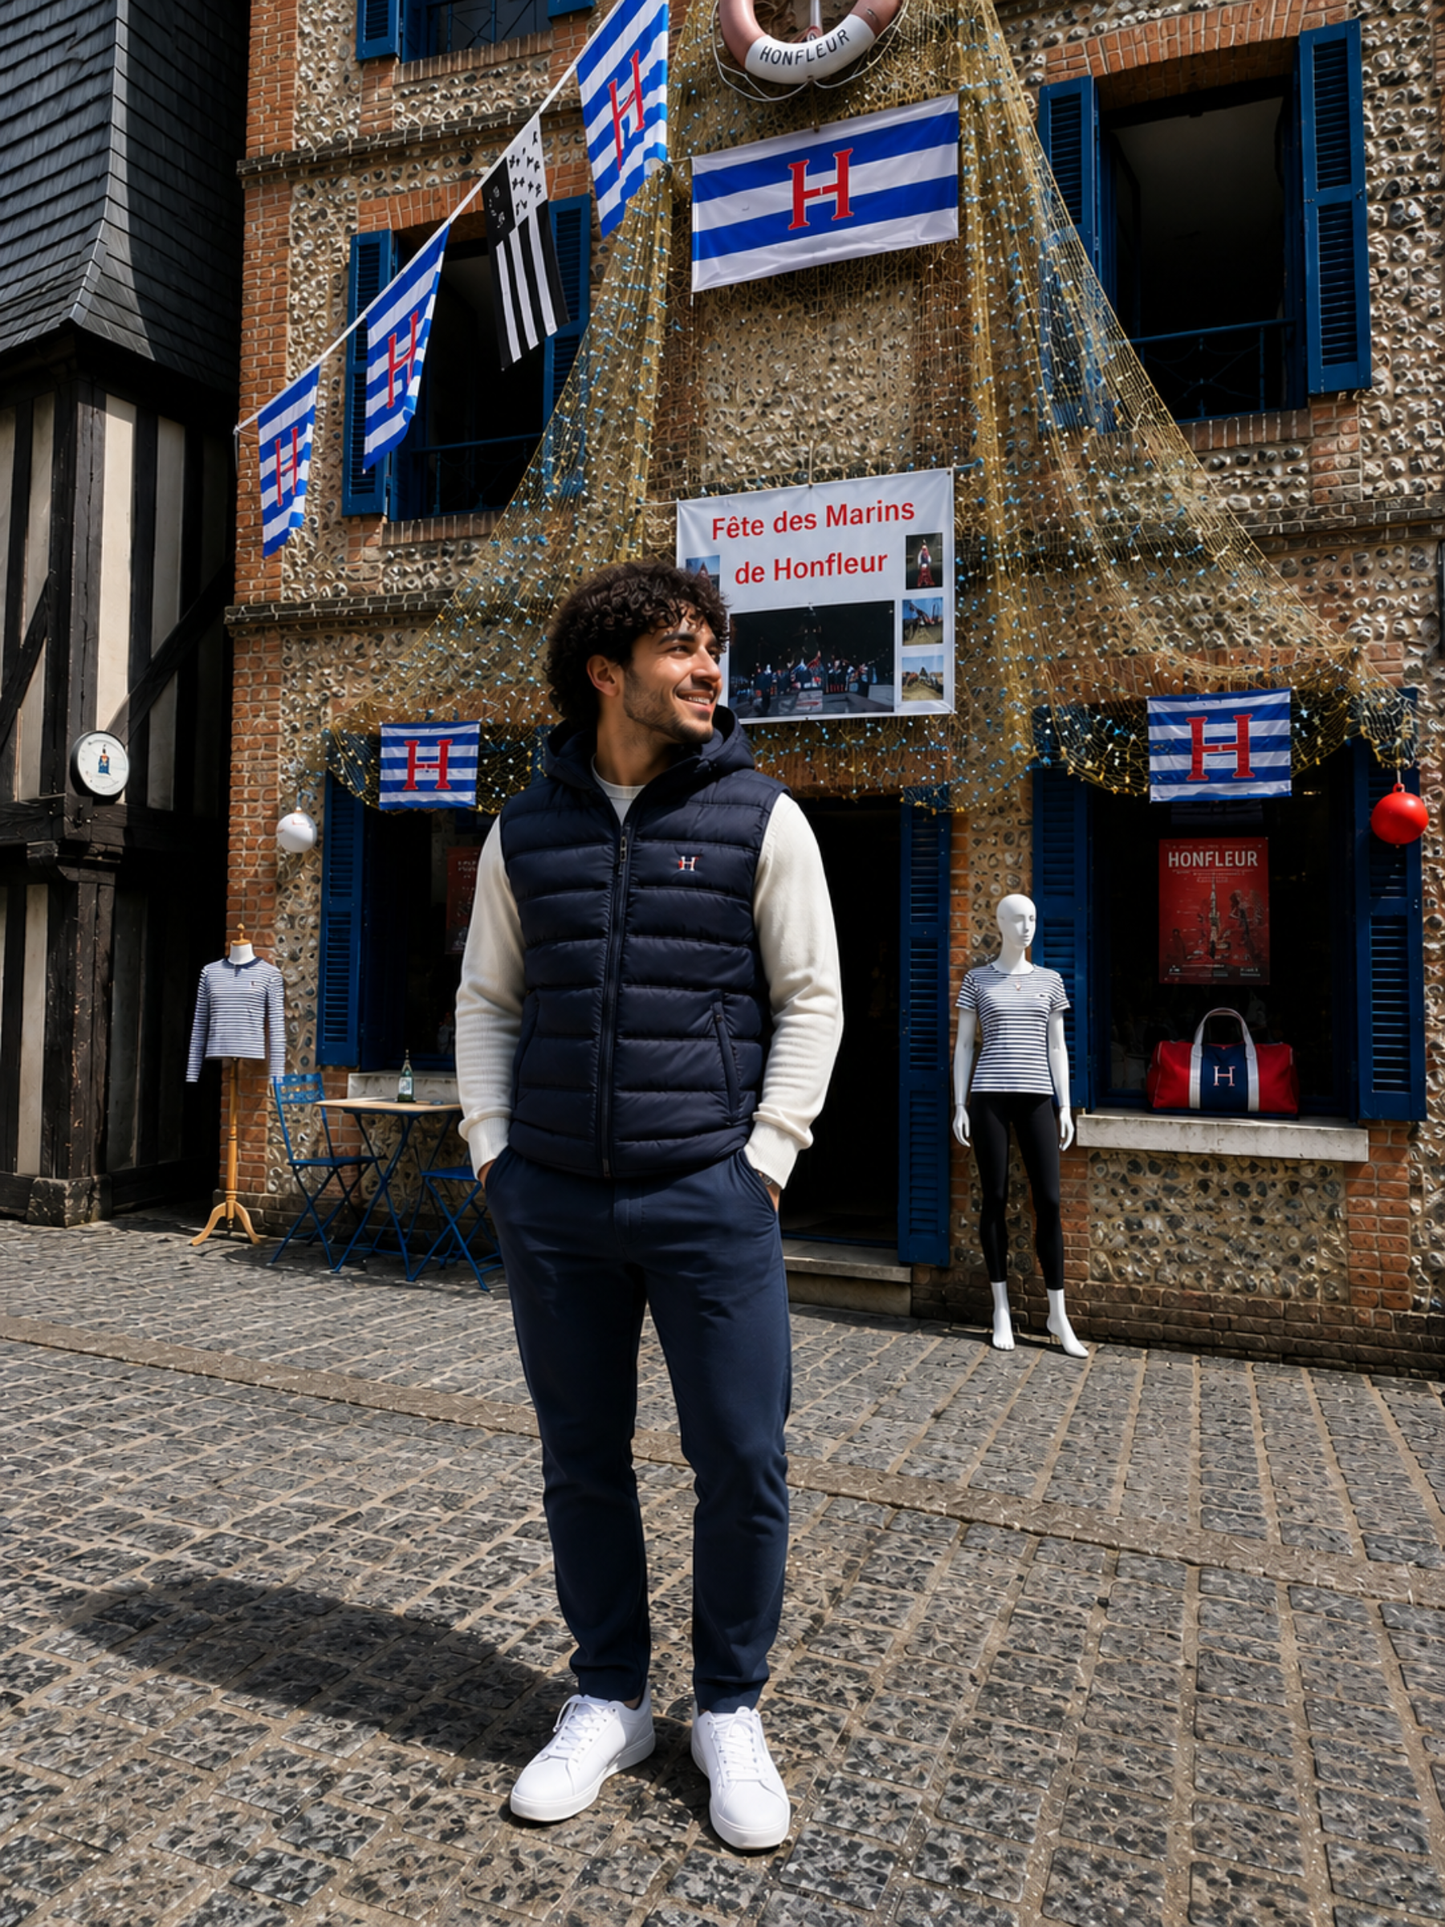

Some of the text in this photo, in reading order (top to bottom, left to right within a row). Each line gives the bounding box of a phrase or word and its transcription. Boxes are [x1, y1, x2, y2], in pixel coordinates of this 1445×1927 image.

[759, 29, 850, 66] HONFLEUR
[786, 147, 855, 231] H
[712, 499, 916, 541] Fête des Marins
[735, 552, 889, 585] de Honfleur
[403, 738, 453, 791] H
[1186, 713, 1255, 781] H
[1168, 850, 1258, 868] HONFLEUR
[1212, 1065, 1236, 1088] H
